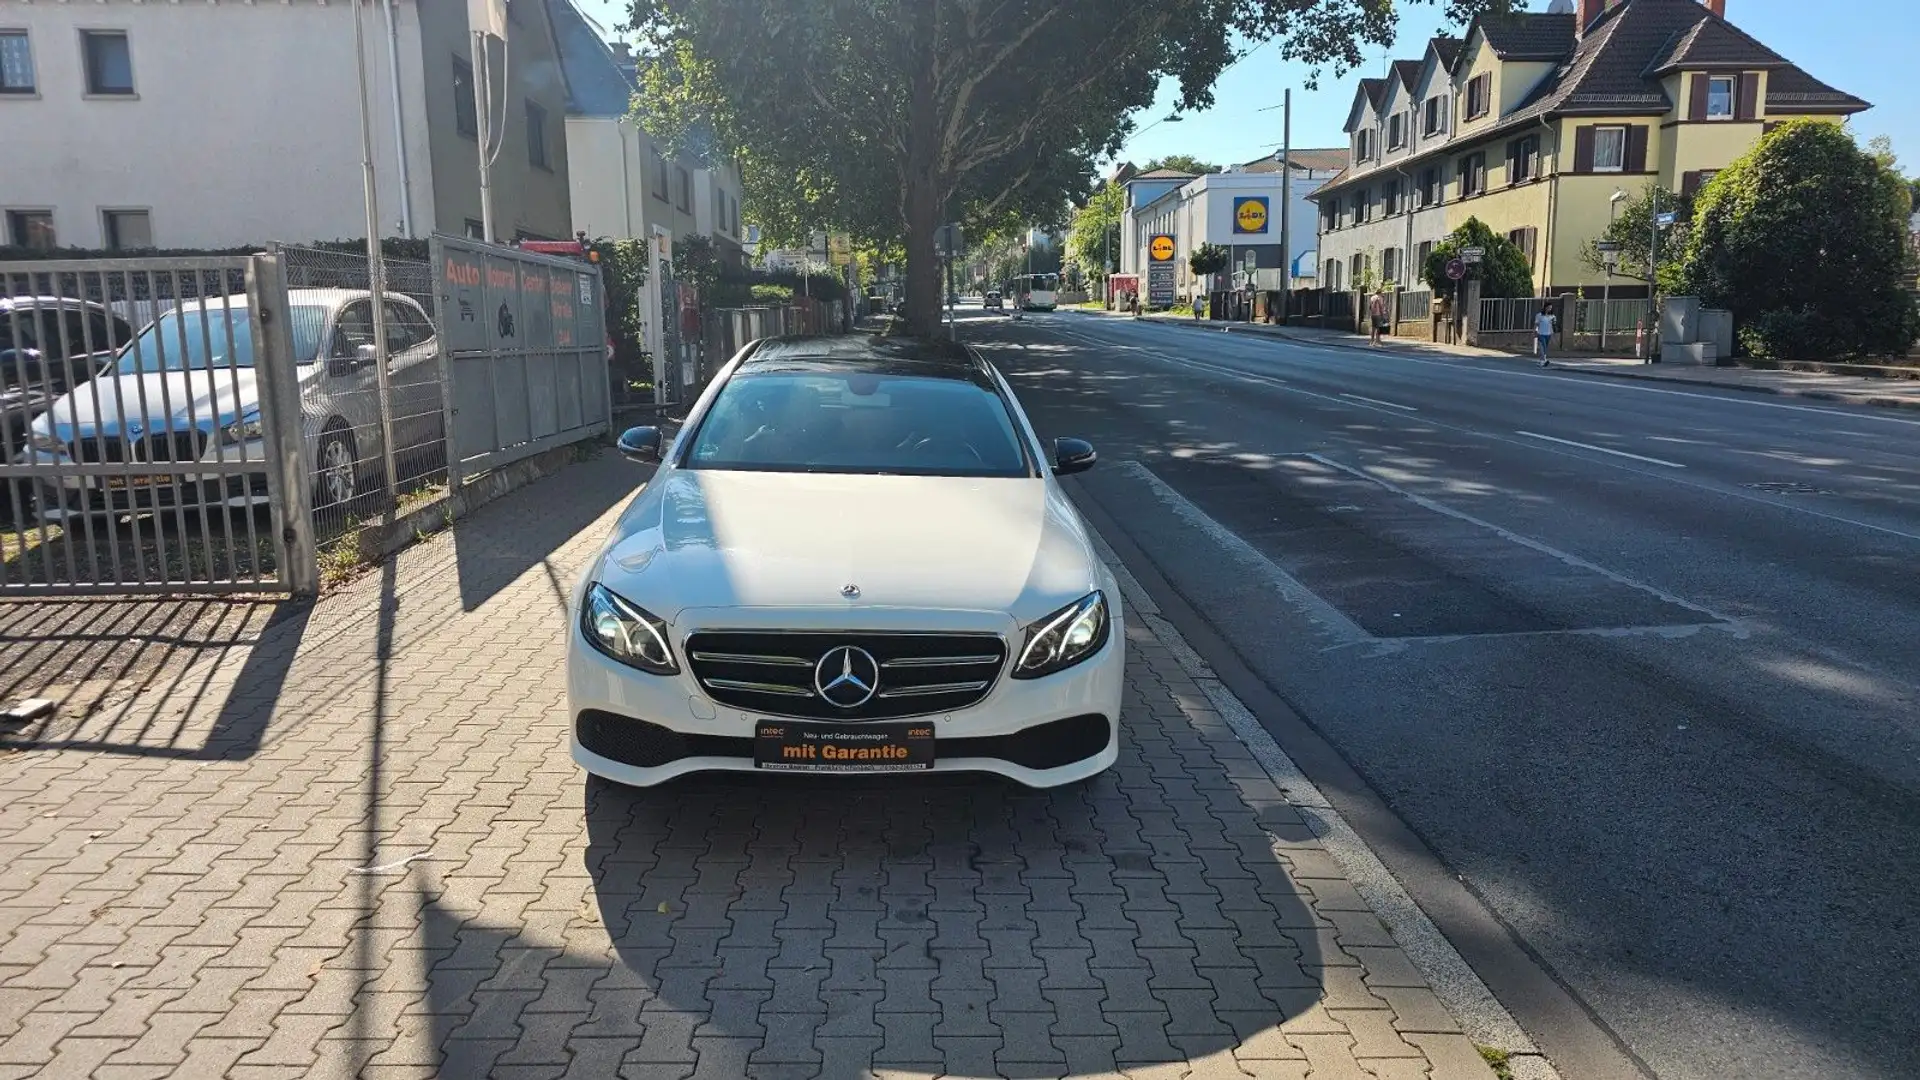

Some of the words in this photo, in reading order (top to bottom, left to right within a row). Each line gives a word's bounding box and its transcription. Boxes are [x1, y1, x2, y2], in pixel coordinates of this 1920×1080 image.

[446, 256, 480, 285] Auto
[783, 743, 816, 759] mit
[821, 744, 908, 760] Garantie
